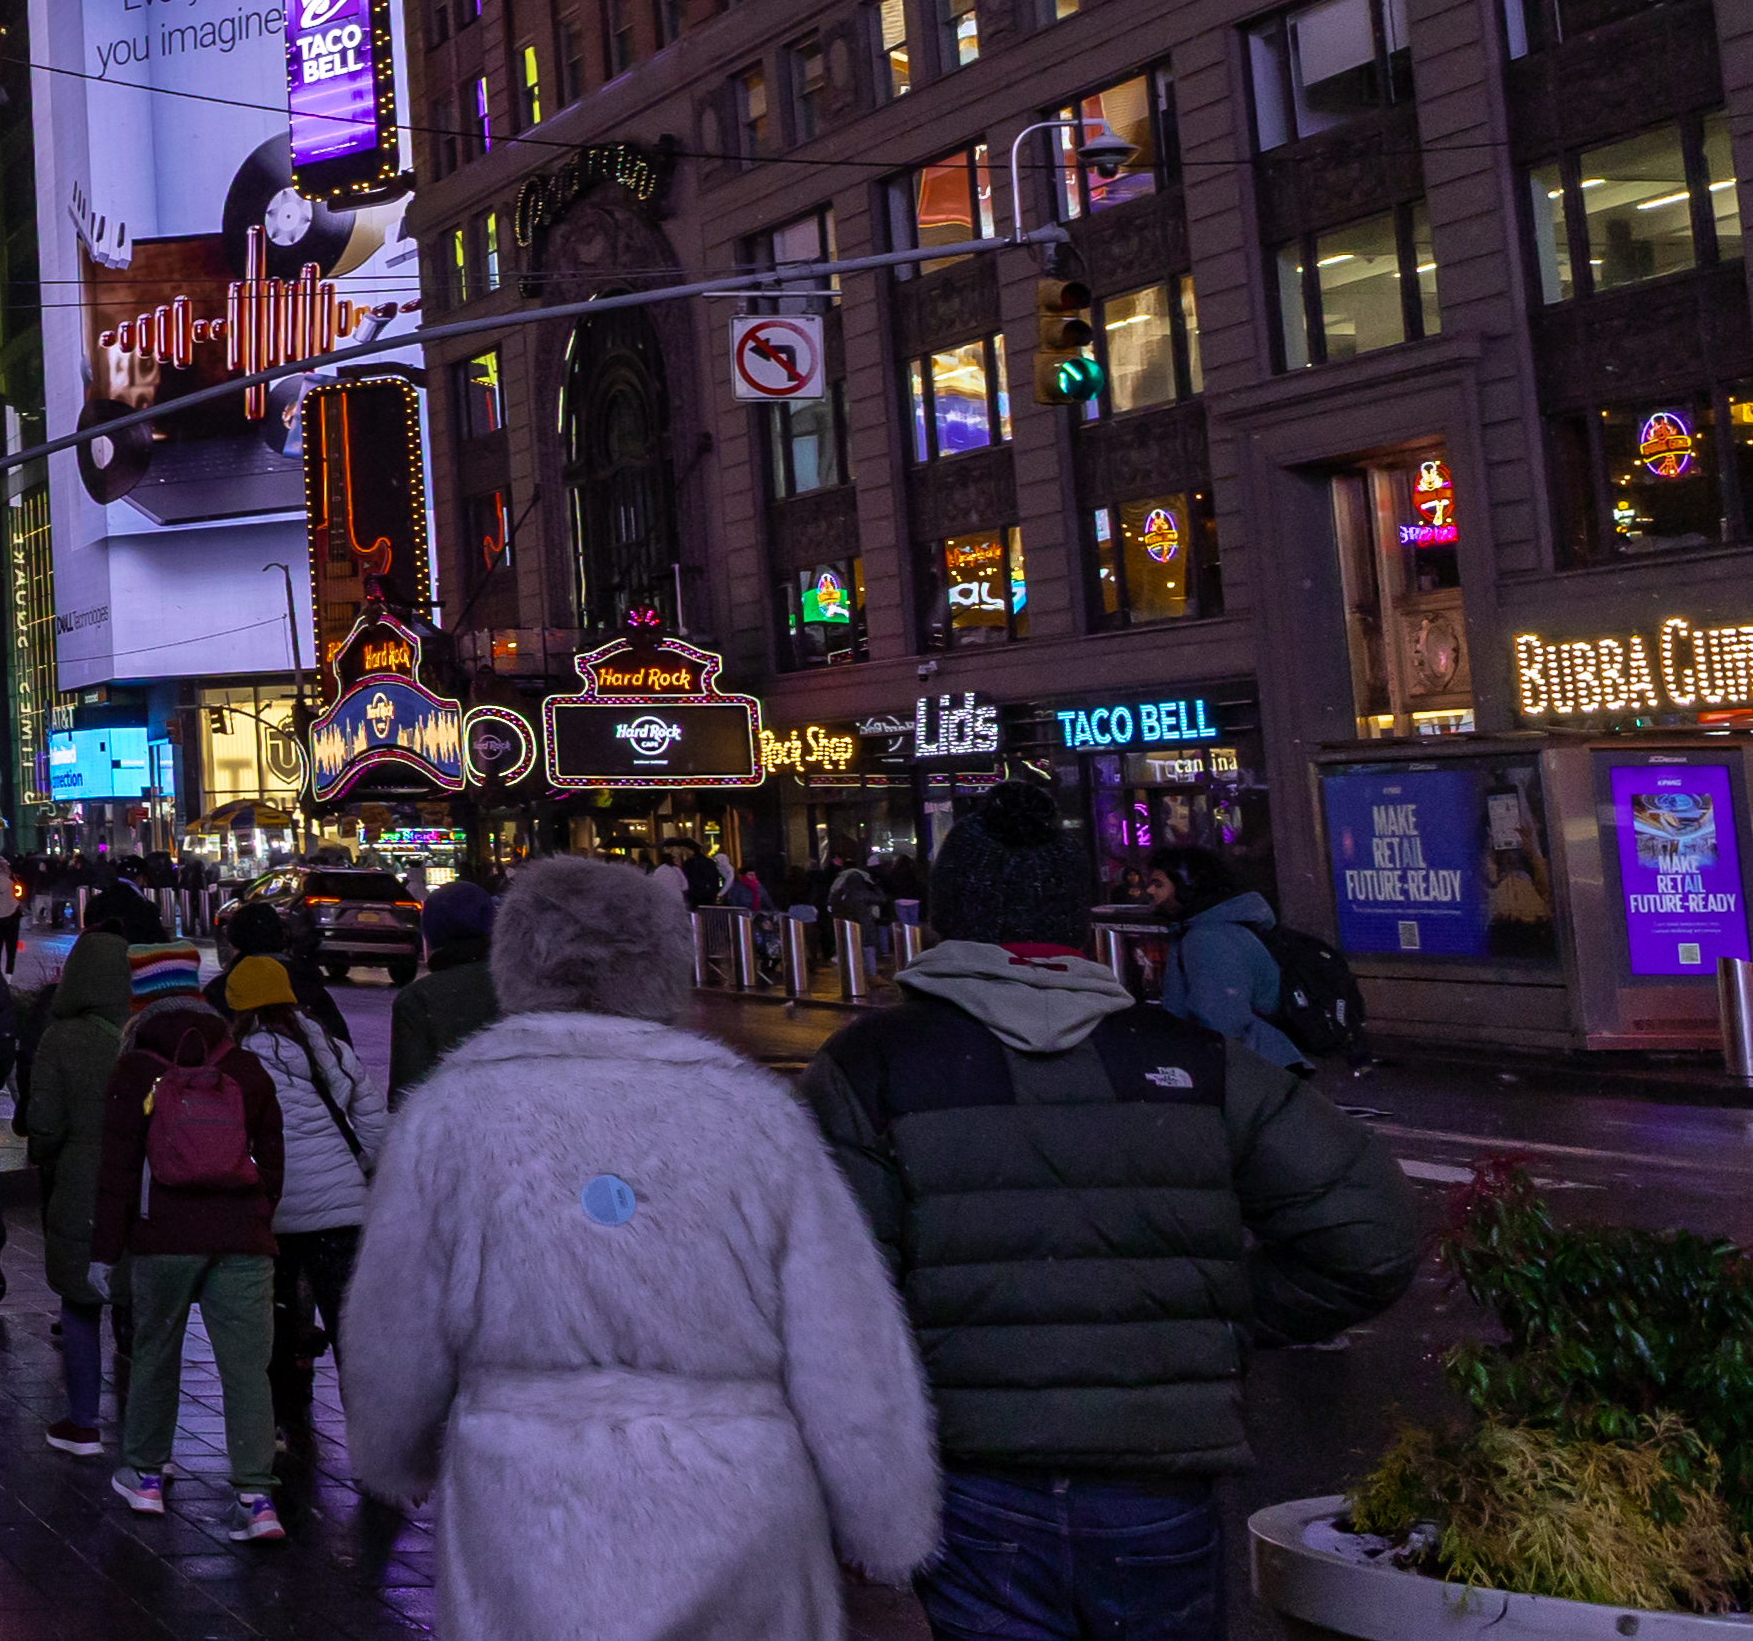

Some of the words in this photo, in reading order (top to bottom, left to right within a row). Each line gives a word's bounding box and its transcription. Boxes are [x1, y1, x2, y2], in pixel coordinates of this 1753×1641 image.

[96, 35, 149, 80] you
[160, 7, 283, 55] imagine
[296, 24, 363, 60] TACO
[303, 49, 363, 84] BELL
[56, 615, 73, 636] DELL
[364, 644, 387, 671] Hard
[389, 642, 411, 671] Rock
[599, 668, 645, 687] Hard
[648, 668, 691, 690] Rock
[1514, 633, 1661, 715] BUBBA
[52, 706, 75, 731] AT&T
[616, 724, 650, 738] Hard
[650, 724, 682, 743] Rock
[1057, 706, 1133, 748] TACO
[1139, 699, 1216, 742] BELL
[806, 726, 853, 770] Shop
[1175, 753, 1239, 773] canina
[1372, 804, 1419, 836] MAKE
[1372, 836, 1427, 869] RETAIL
[1658, 855, 1700, 874] MAKE
[1345, 870, 1462, 902] FUTURE-READY
[1657, 874, 1706, 894] RETAIL
[1630, 894, 1736, 913] FUTURE-READY
